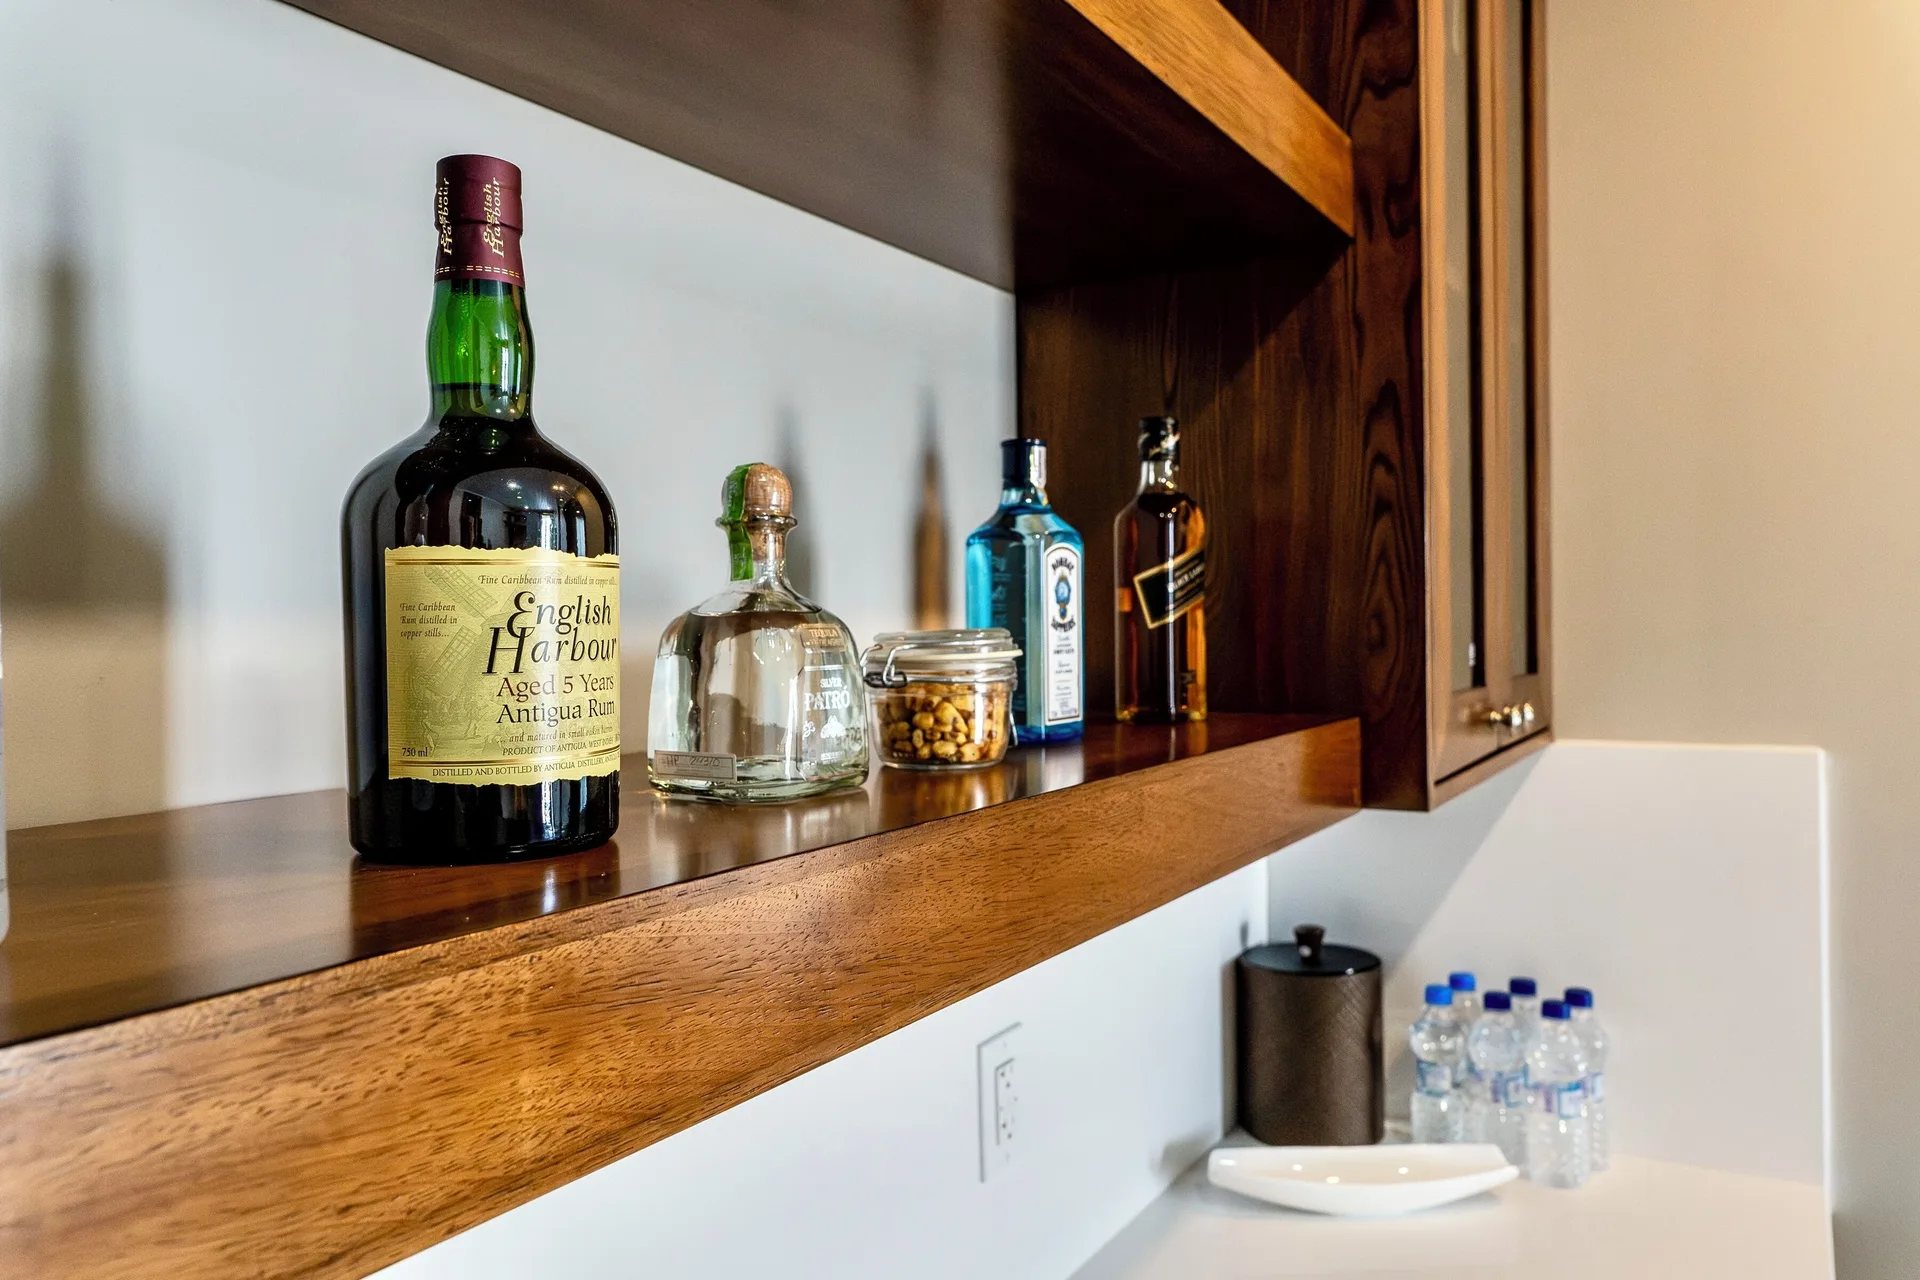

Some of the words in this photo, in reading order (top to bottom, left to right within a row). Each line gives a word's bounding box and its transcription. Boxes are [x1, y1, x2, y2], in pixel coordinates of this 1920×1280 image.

[492, 177, 504, 258] Harbour
[478, 575, 498, 584] Fine
[501, 574, 541, 585] Caribbean
[564, 574, 587, 585] distilled
[400, 602, 416, 611] Fine
[418, 601, 456, 611] Caribbean
[400, 615, 416, 625] Rum
[419, 614, 447, 624] distilled
[450, 615, 457, 624] in
[507, 591, 611, 638] English
[400, 630, 422, 640] copper
[808, 628, 838, 638] TEQUILA
[482, 627, 617, 674] Harbour
[496, 674, 556, 702] Aged
[563, 675, 574, 693] 5
[579, 673, 614, 692] Years
[496, 703, 582, 727] Antigua
[588, 699, 615, 718] Rum
[509, 732, 524, 743] and
[527, 731, 557, 742] matured
[559, 730, 566, 739] in
[568, 727, 584, 739] small
[401, 747, 416, 757] 750
[418, 747, 428, 757] ml
[502, 745, 543, 756] PRODUCT
[545, 744, 557, 753] OF
[432, 768, 473, 777] DISTILLED
[475, 767, 494, 776] AND
[496, 765, 532, 775] BOTTLED
[533, 764, 543, 773] BY
[544, 761, 575, 772] ANTIGUA
